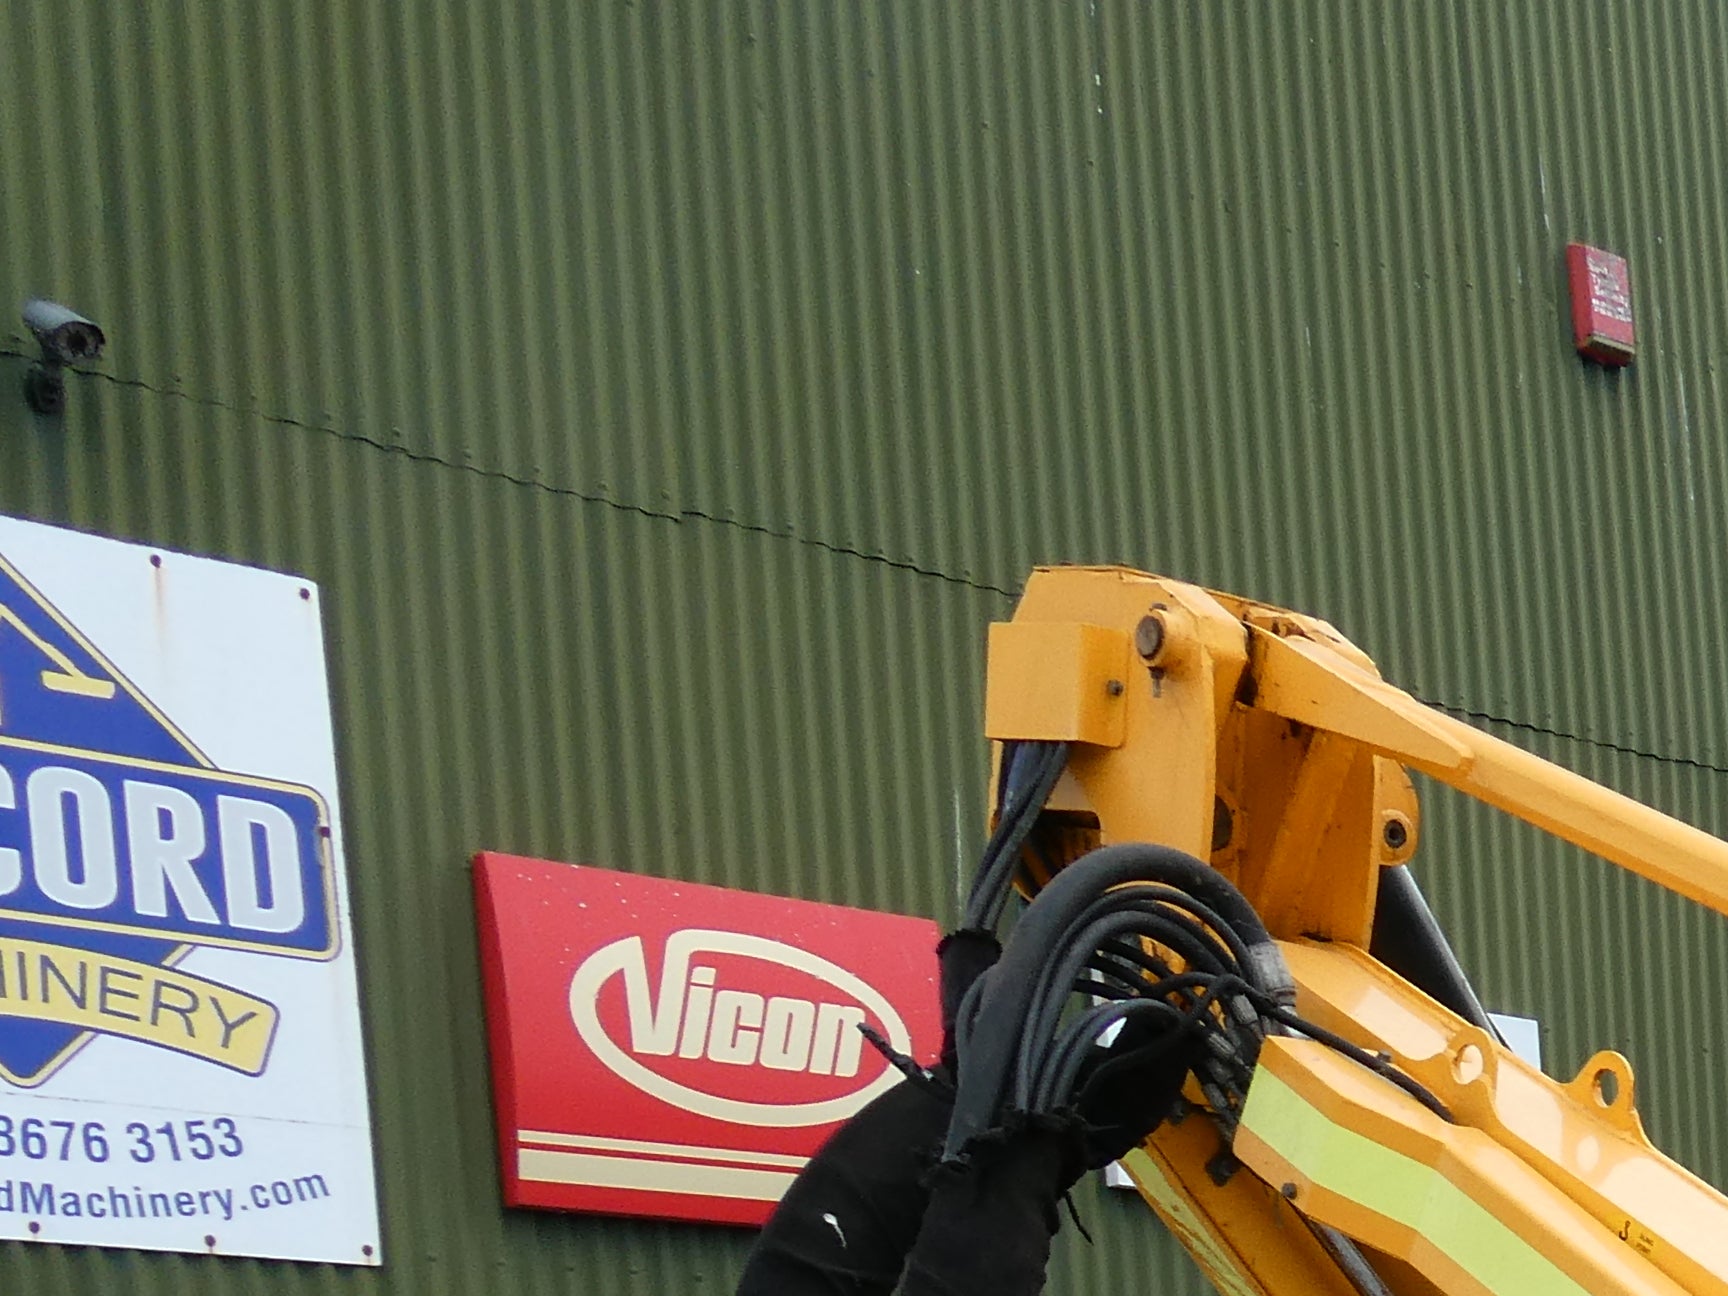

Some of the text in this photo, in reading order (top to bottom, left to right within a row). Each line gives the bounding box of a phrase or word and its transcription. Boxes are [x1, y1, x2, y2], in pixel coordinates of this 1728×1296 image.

[0, 764, 305, 934] ORD
[0, 950, 258, 1050] INERY
[620, 929, 872, 1079] Vicon
[126, 1117, 244, 1164] 3153
